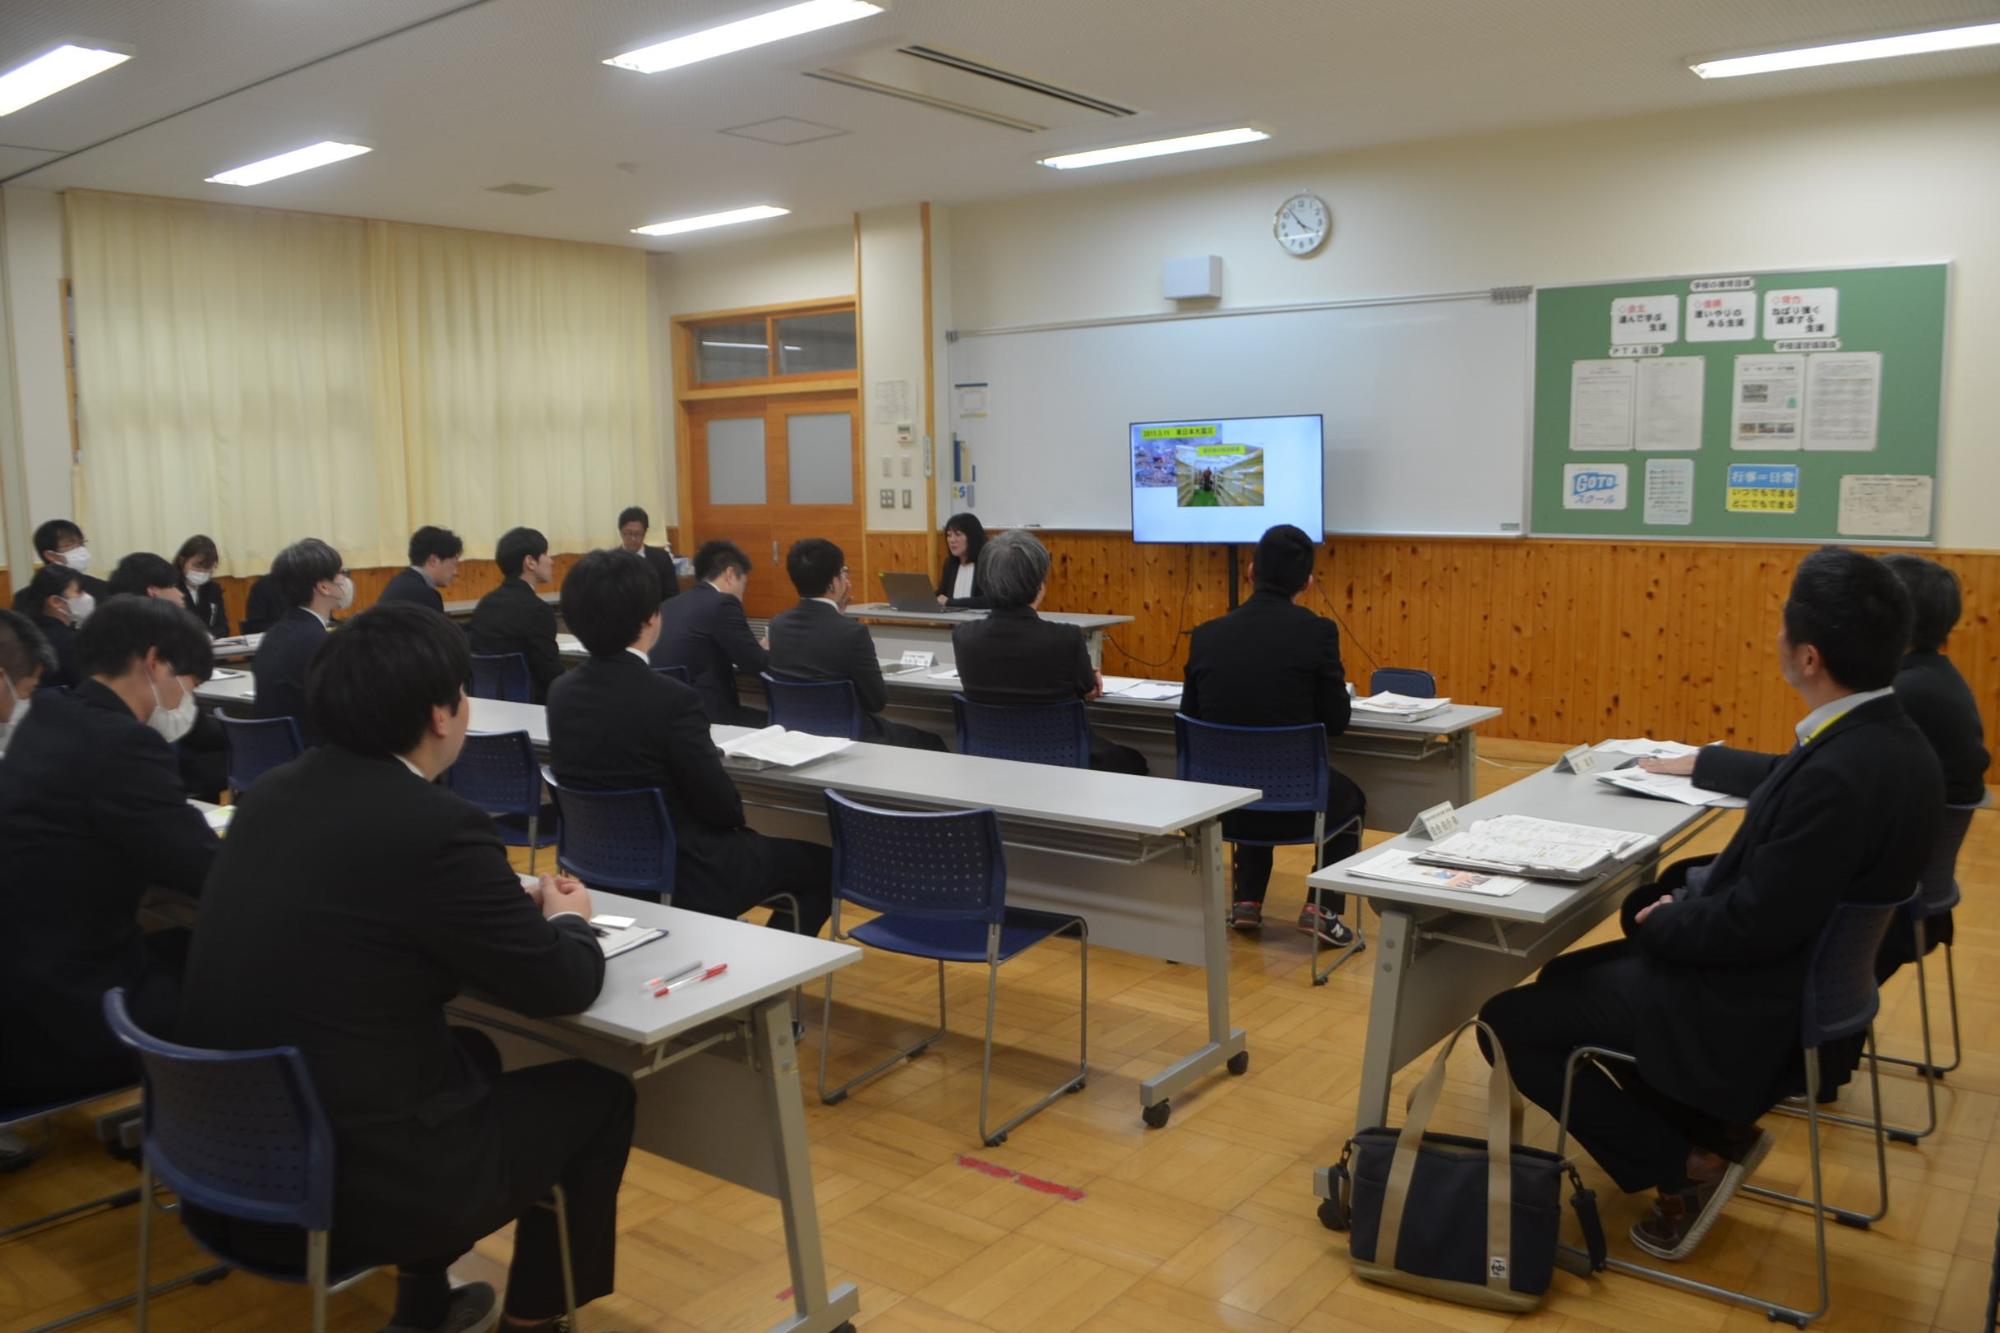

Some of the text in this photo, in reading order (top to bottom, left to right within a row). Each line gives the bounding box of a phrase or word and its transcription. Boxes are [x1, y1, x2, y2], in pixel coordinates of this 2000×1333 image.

[1695, 309, 1742, 319] 思いやりの
[1707, 318, 1744, 327] ある生徒
[1649, 323, 1667, 332] 生徒
[1806, 323, 1824, 332] 生徒
